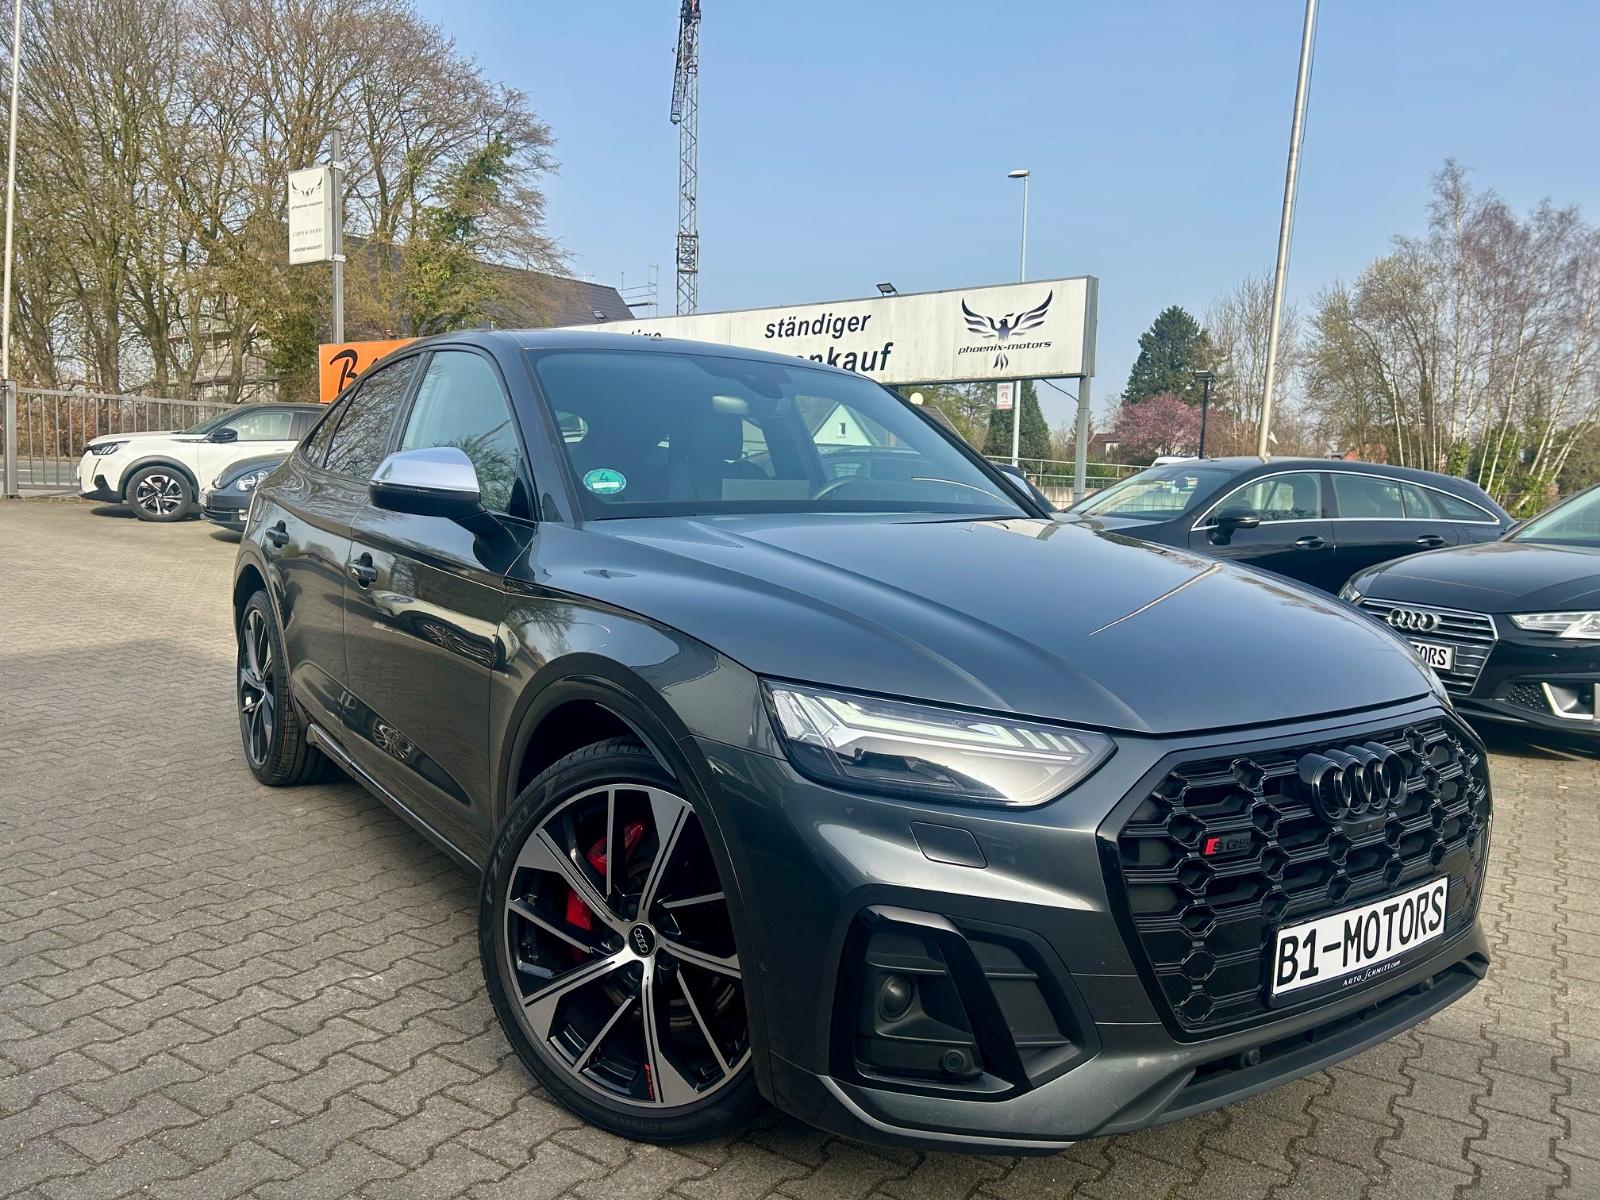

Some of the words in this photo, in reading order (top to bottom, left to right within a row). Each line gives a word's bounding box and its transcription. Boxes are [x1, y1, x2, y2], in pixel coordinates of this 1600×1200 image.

[764, 313, 871, 338] ständiger
[958, 341, 1052, 355] phoenix-motors
[600, 472, 610, 481] 4
[1276, 886, 1444, 987] B1-MOTORS
[1343, 975, 1362, 986] AUTO
